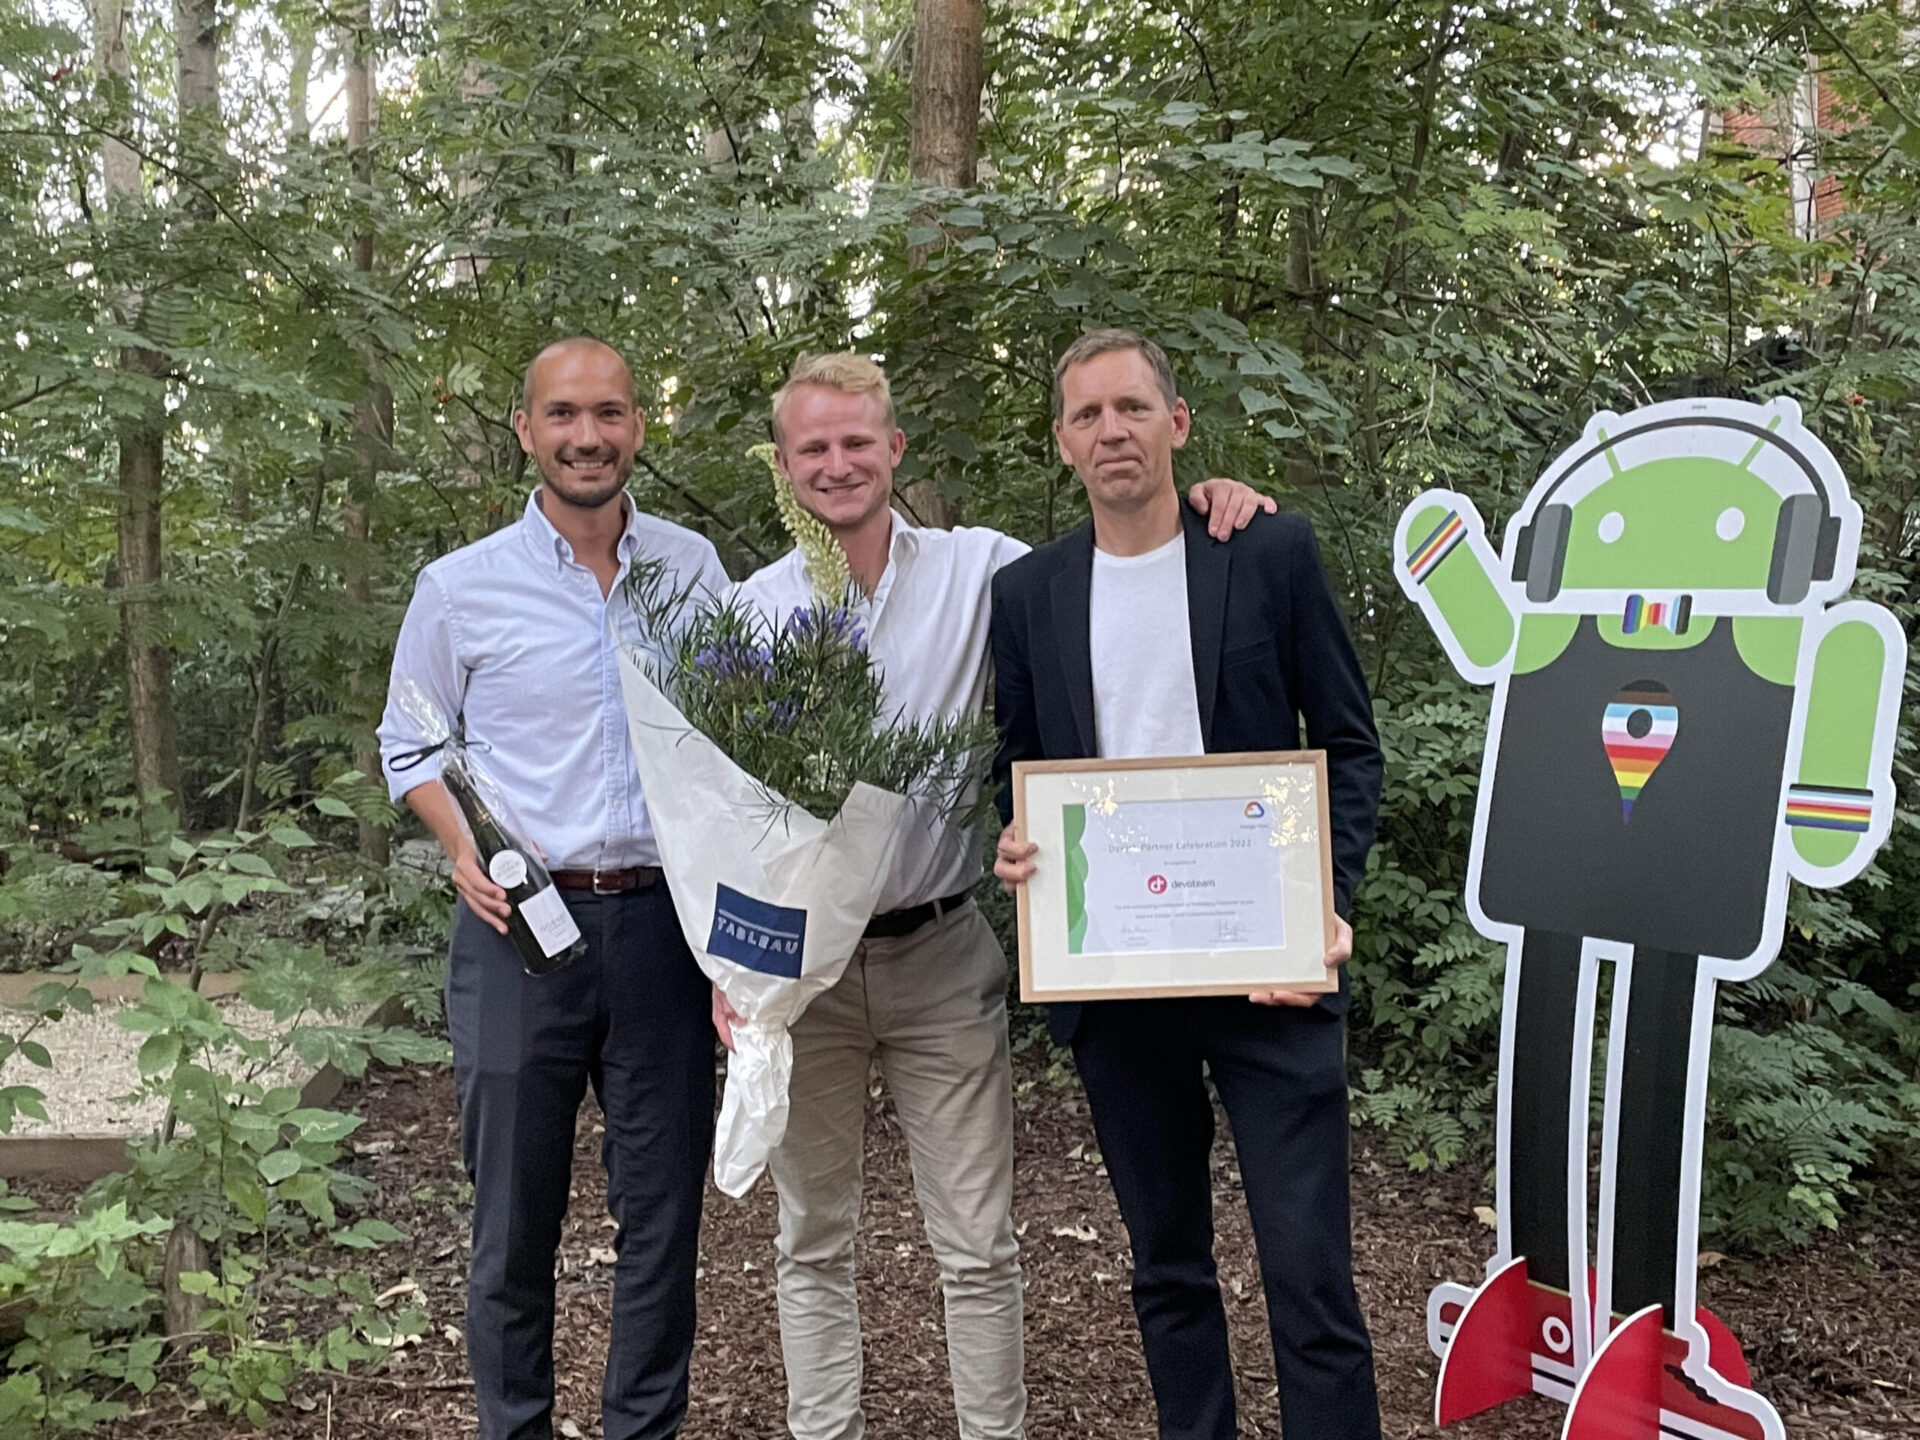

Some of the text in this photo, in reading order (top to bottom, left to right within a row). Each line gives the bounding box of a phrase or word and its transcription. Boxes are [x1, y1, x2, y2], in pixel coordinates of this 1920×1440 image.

[1141, 843, 1173, 852] Partner
[1176, 840, 1227, 849] Celebration
[1230, 838, 1251, 848] 2022
[1171, 879, 1215, 889] devoteam
[716, 916, 799, 955] TABLEAU
